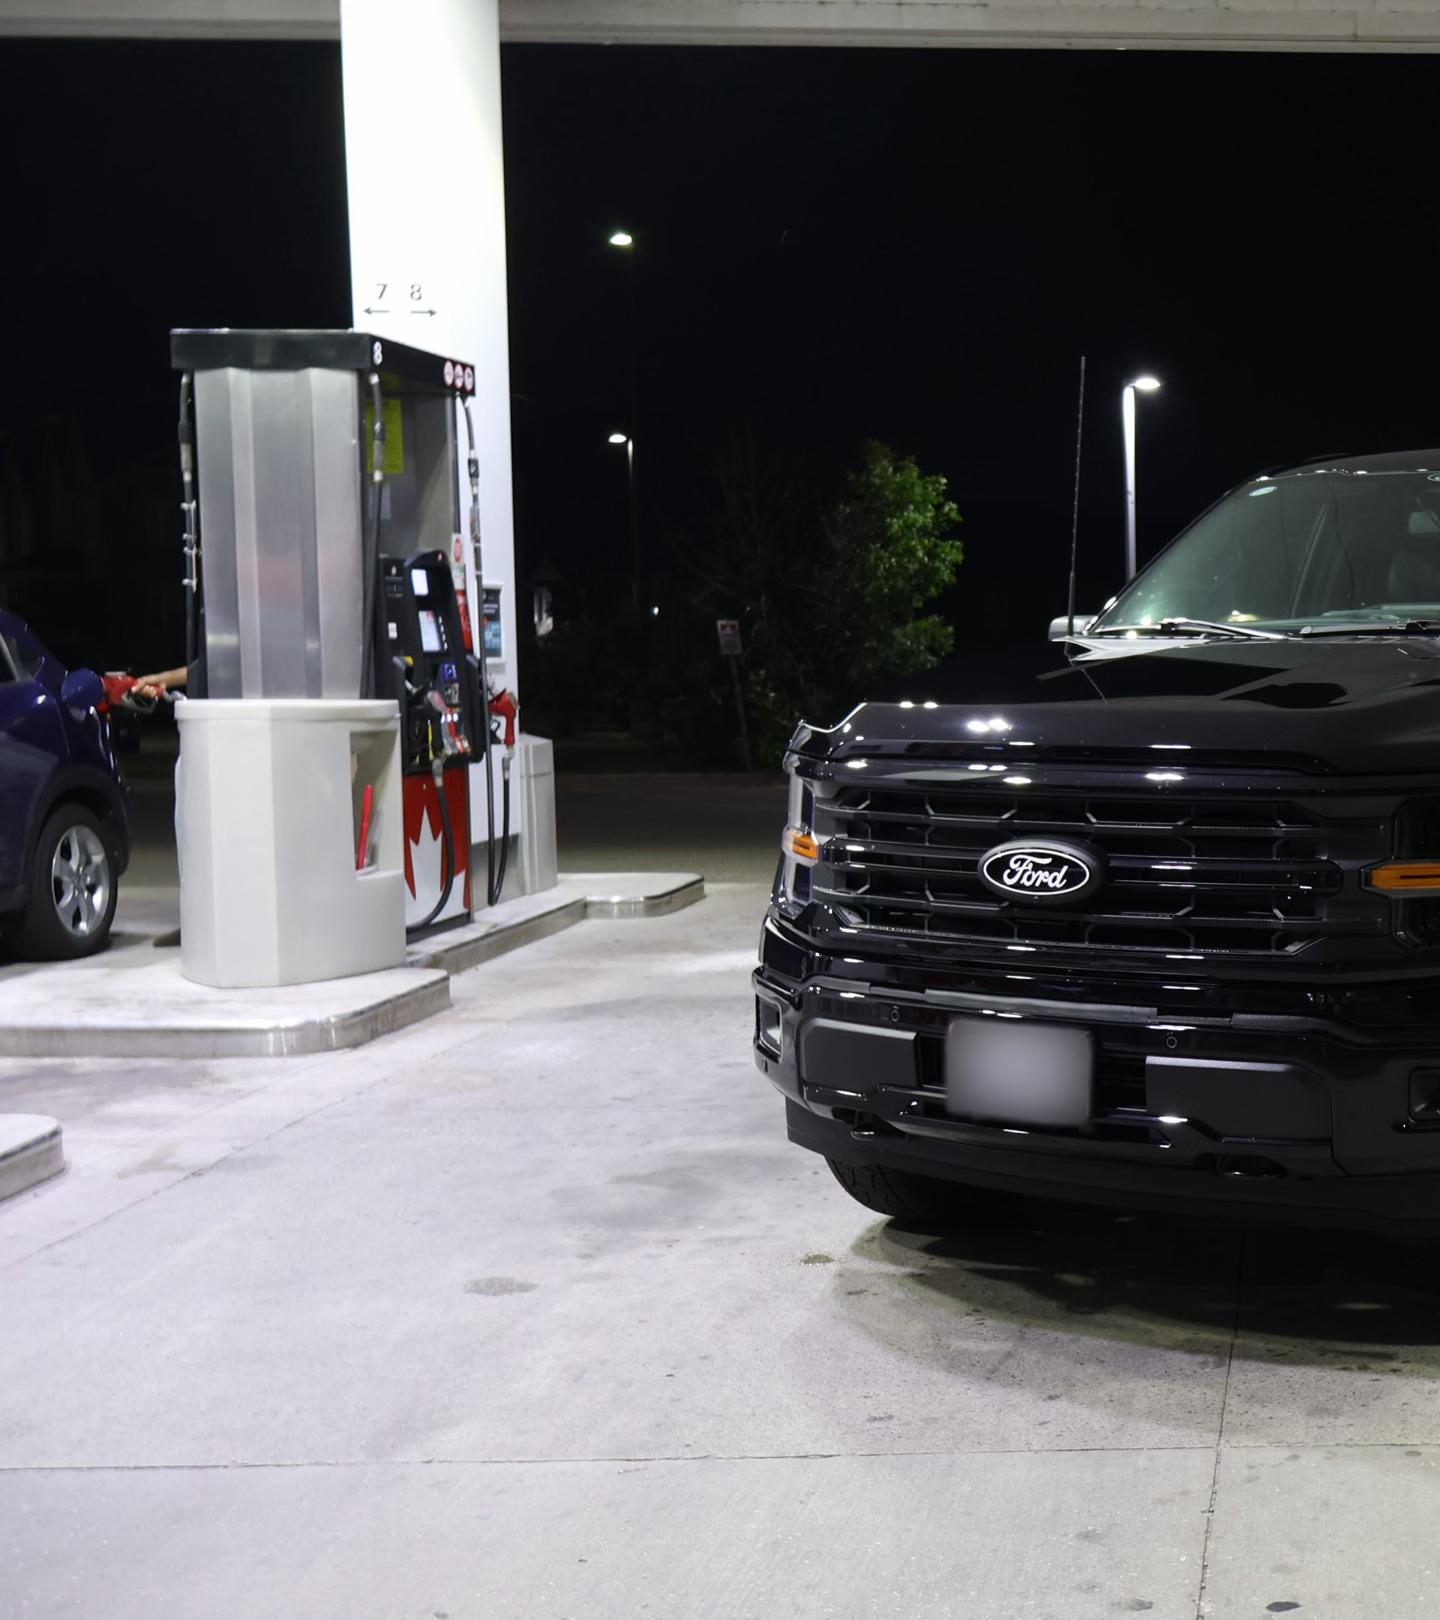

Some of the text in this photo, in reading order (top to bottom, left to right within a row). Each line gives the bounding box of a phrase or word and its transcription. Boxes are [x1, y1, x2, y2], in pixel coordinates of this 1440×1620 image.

[376, 283, 422, 300] 7 8
[373, 341, 383, 366] 8
[1003, 855, 1069, 888] Ford
